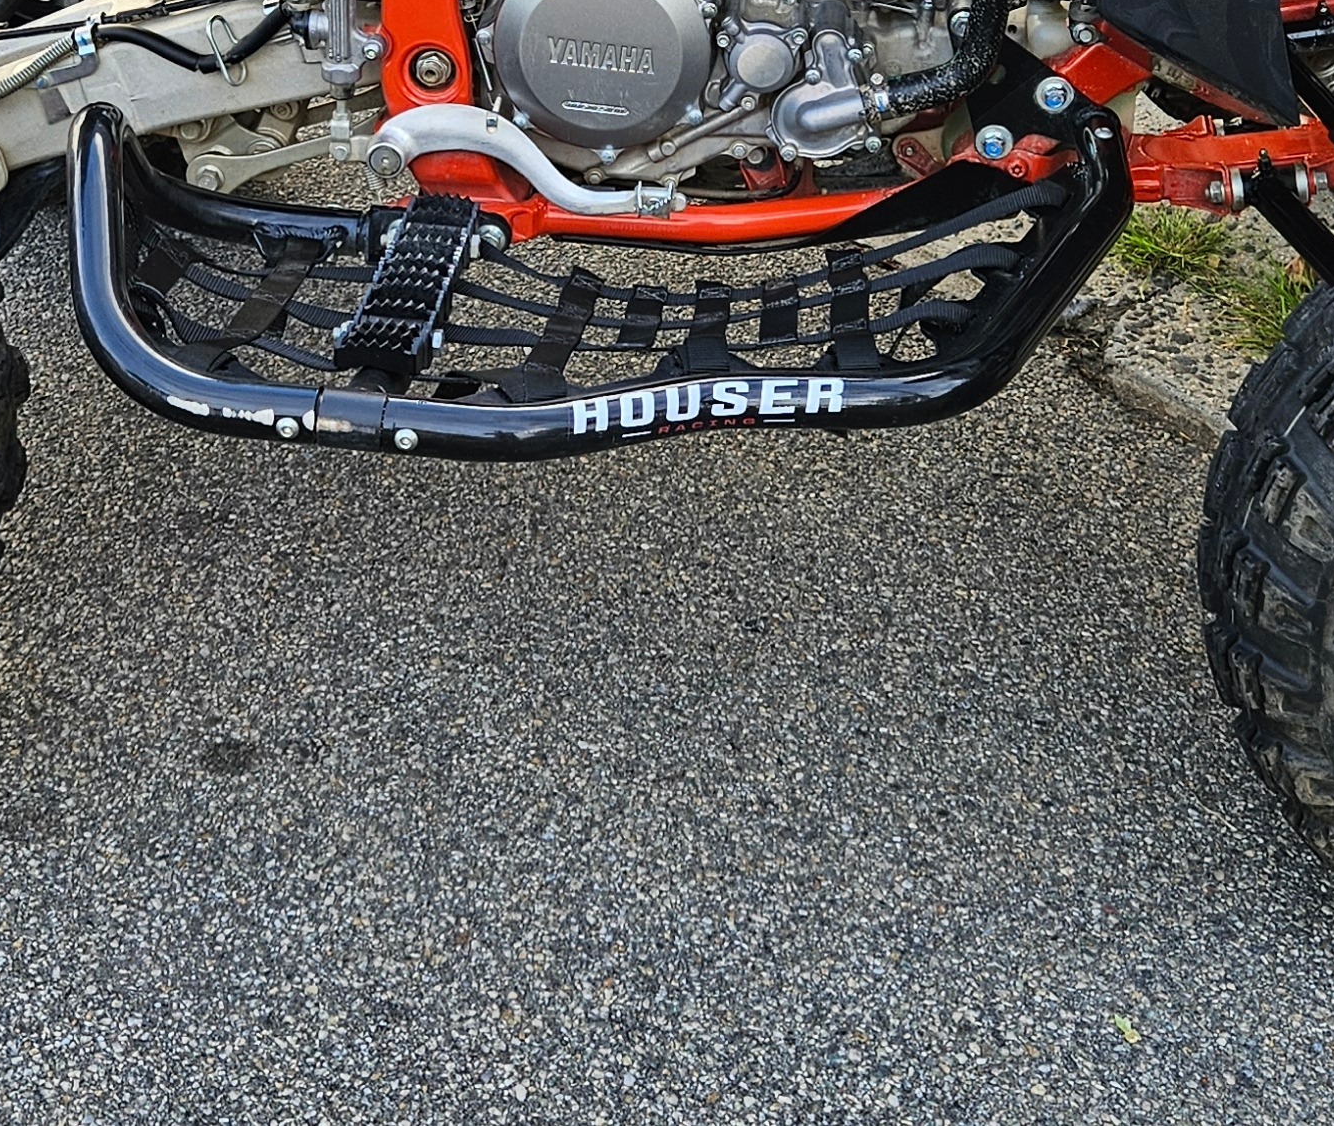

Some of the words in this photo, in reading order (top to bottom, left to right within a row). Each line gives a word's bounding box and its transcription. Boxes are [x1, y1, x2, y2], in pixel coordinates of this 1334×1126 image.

[546, 35, 655, 75] YAMAHA
[572, 378, 846, 435] HOUSER
[657, 417, 757, 435] RACING
